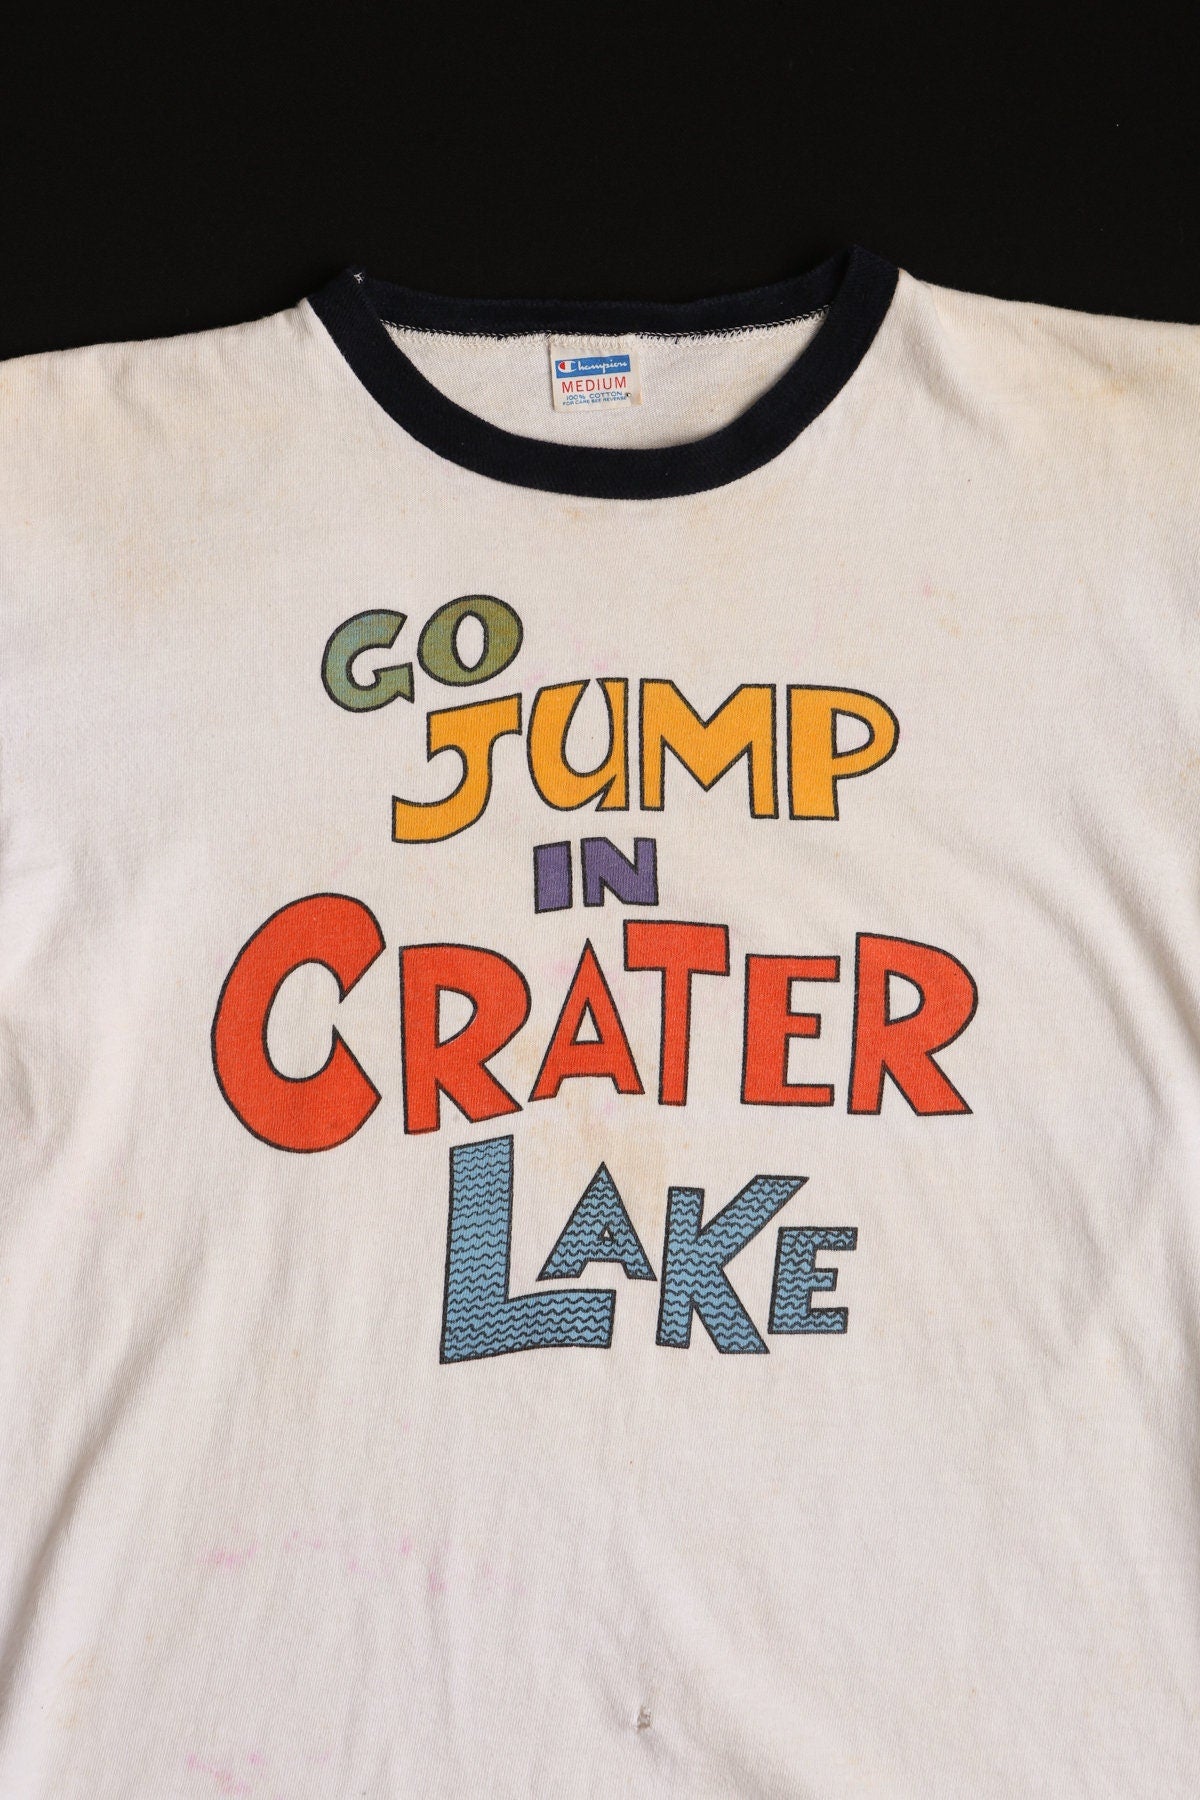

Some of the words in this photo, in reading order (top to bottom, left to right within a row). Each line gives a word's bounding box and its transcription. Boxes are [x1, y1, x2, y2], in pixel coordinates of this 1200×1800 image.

[561, 376, 627, 394] MEDIUM
[589, 391, 623, 399] COTTON
[321, 594, 524, 713] GO
[391, 677, 900, 844] JUMP
[533, 836, 659, 914] IN
[211, 892, 979, 1152] CRATER
[439, 1134, 858, 1364] LAKE
